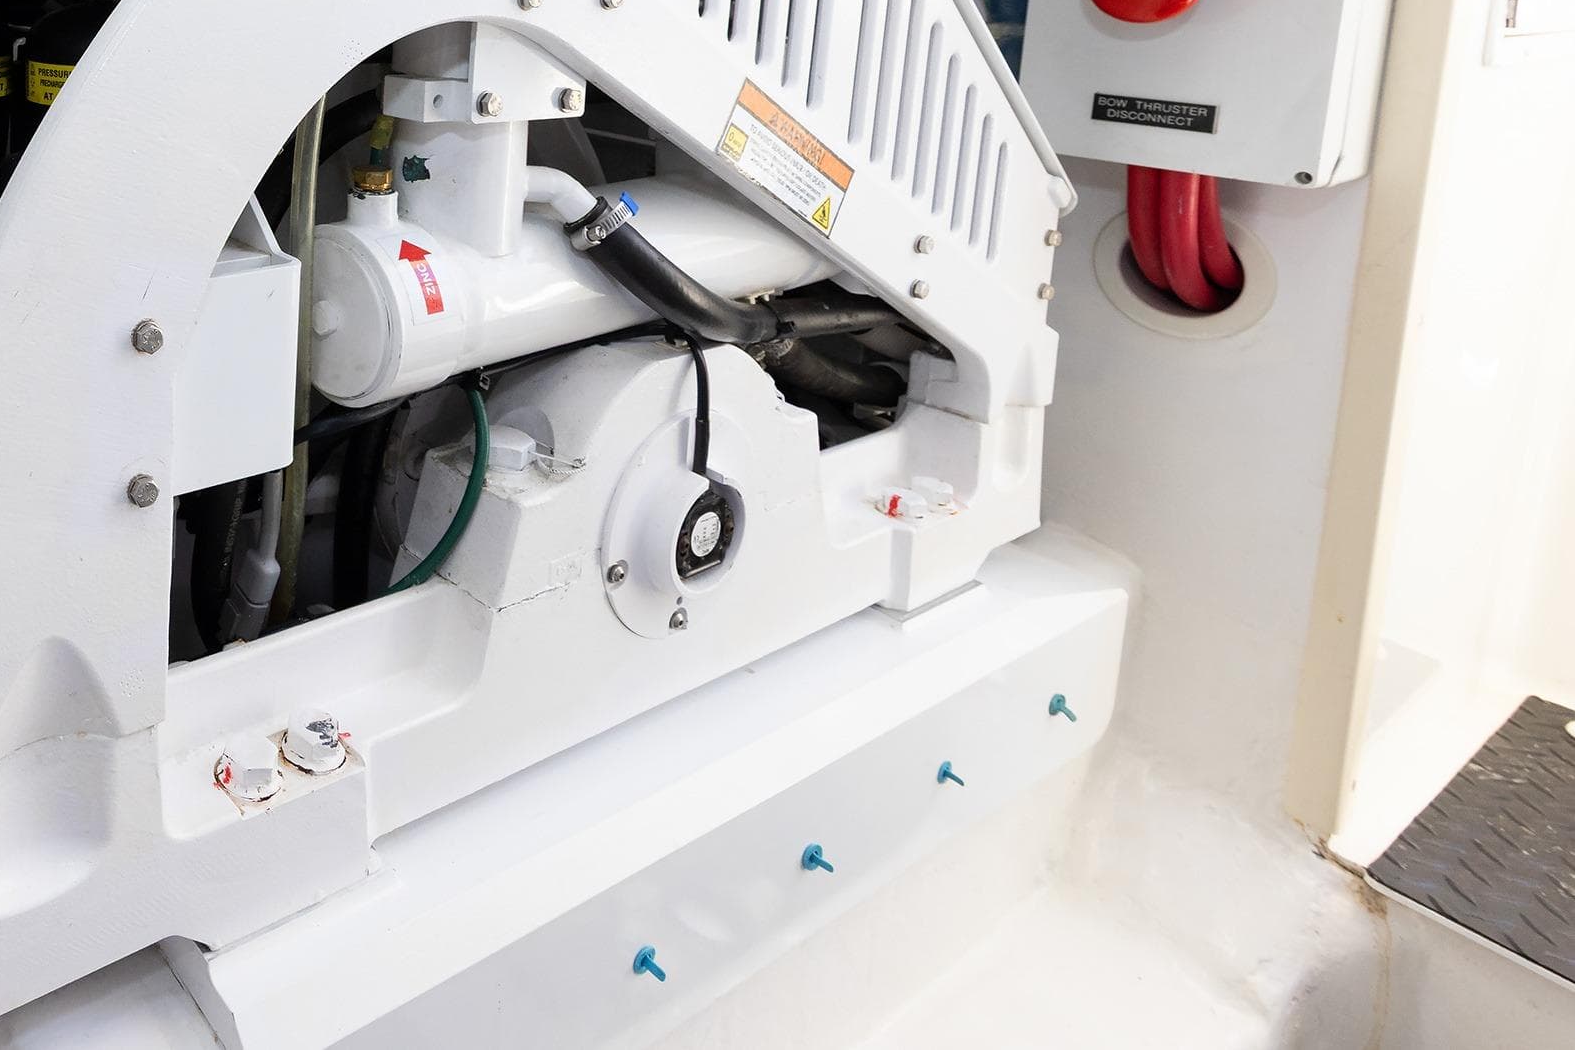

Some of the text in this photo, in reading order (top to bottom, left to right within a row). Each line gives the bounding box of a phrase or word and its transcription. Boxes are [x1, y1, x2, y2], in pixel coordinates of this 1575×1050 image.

[43, 92, 53, 101] AT
[1097, 96, 1209, 118] BOW THRUSTER
[1106, 108, 1194, 128] DISCONNECT
[416, 263, 436, 295] ZINC
